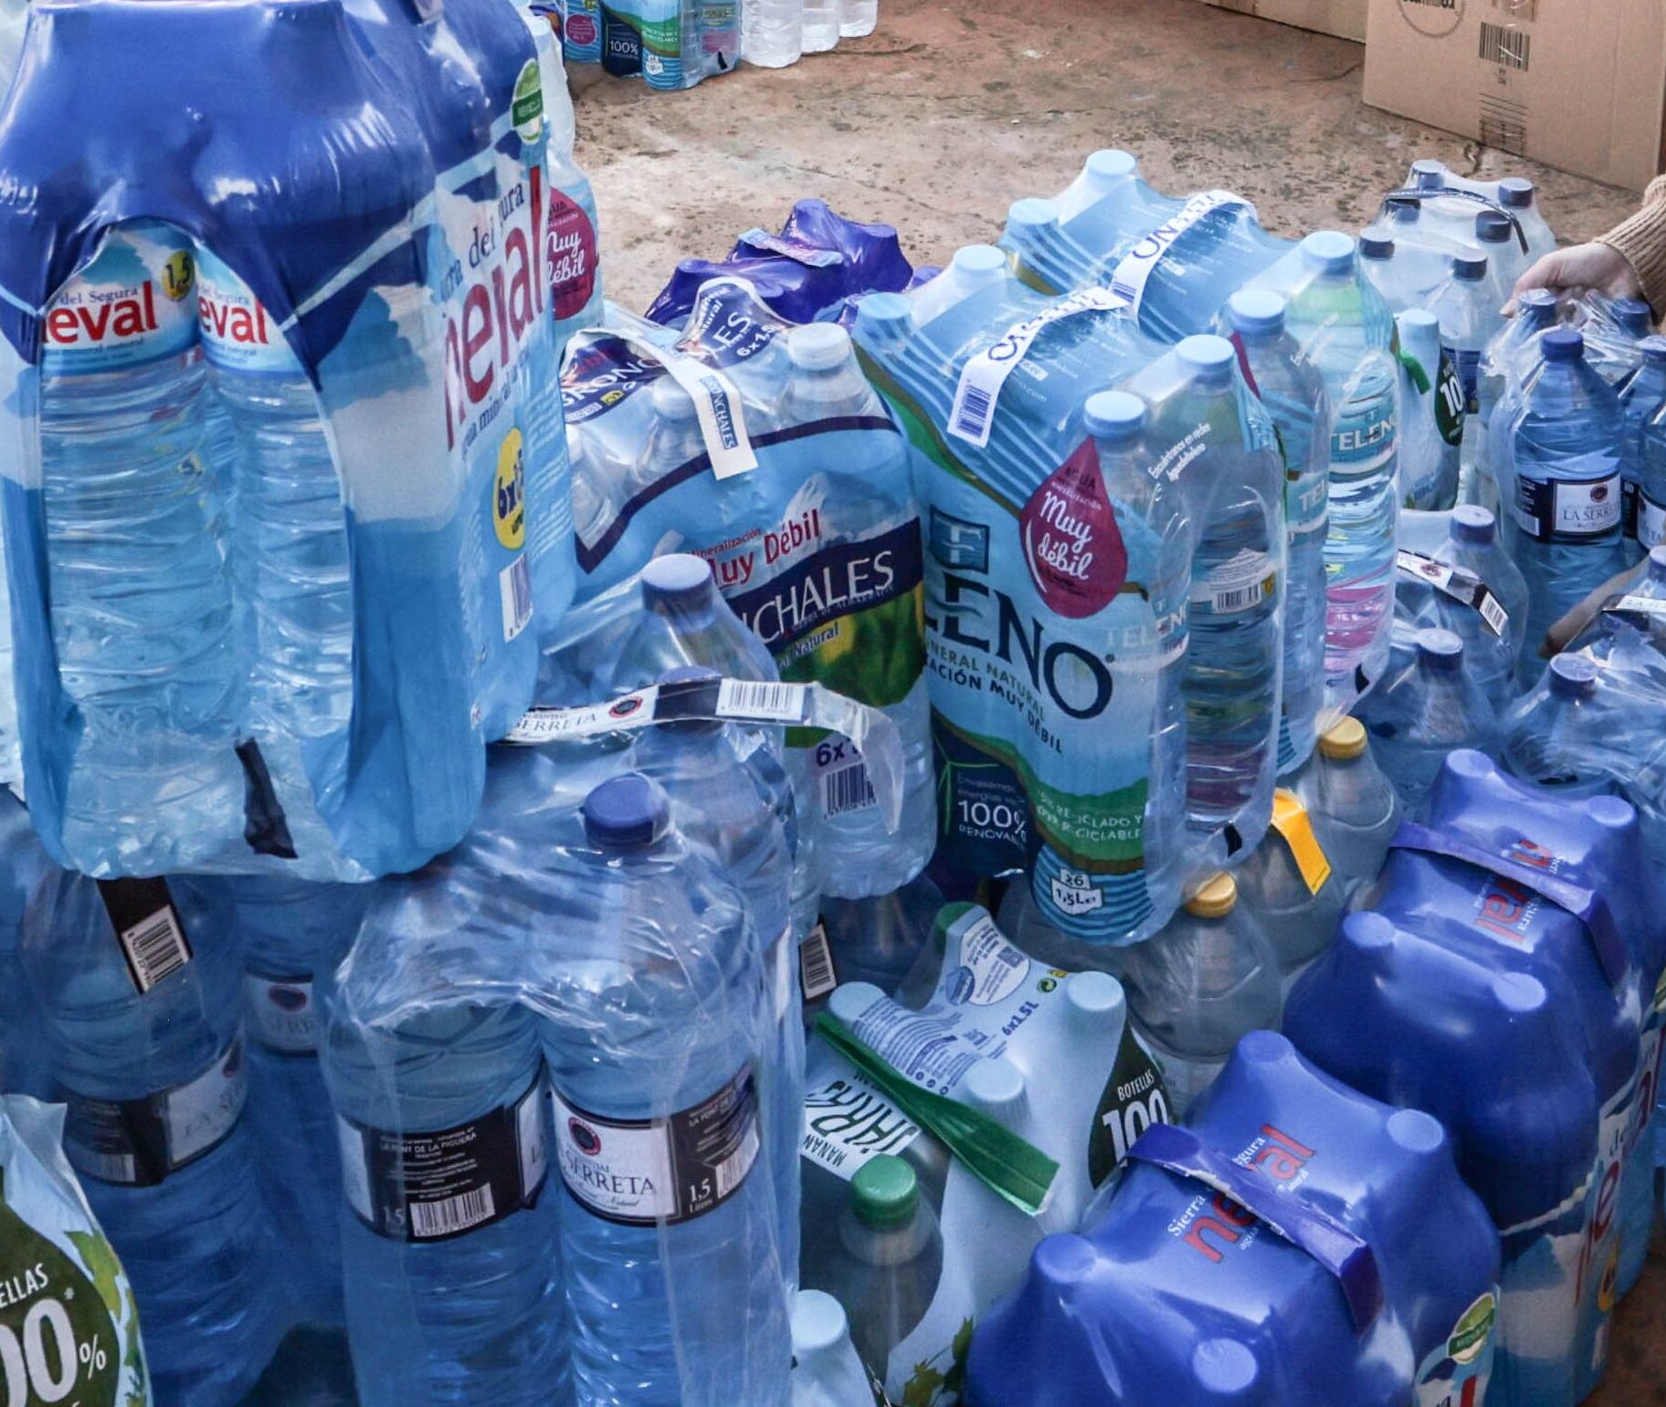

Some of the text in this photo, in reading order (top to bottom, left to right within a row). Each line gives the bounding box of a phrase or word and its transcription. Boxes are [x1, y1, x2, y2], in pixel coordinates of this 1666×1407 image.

[609, 39, 640, 57] 100%
[199, 295, 270, 345] eval
[763, 507, 821, 567] Débil
[1039, 491, 1094, 554] Muy
[1036, 532, 1093, 582] débil
[989, 678, 1063, 756] MUY DÉBIL
[1116, 1069, 1155, 1101] BOTELLAS
[1166, 1192, 1208, 1237] Sierra
